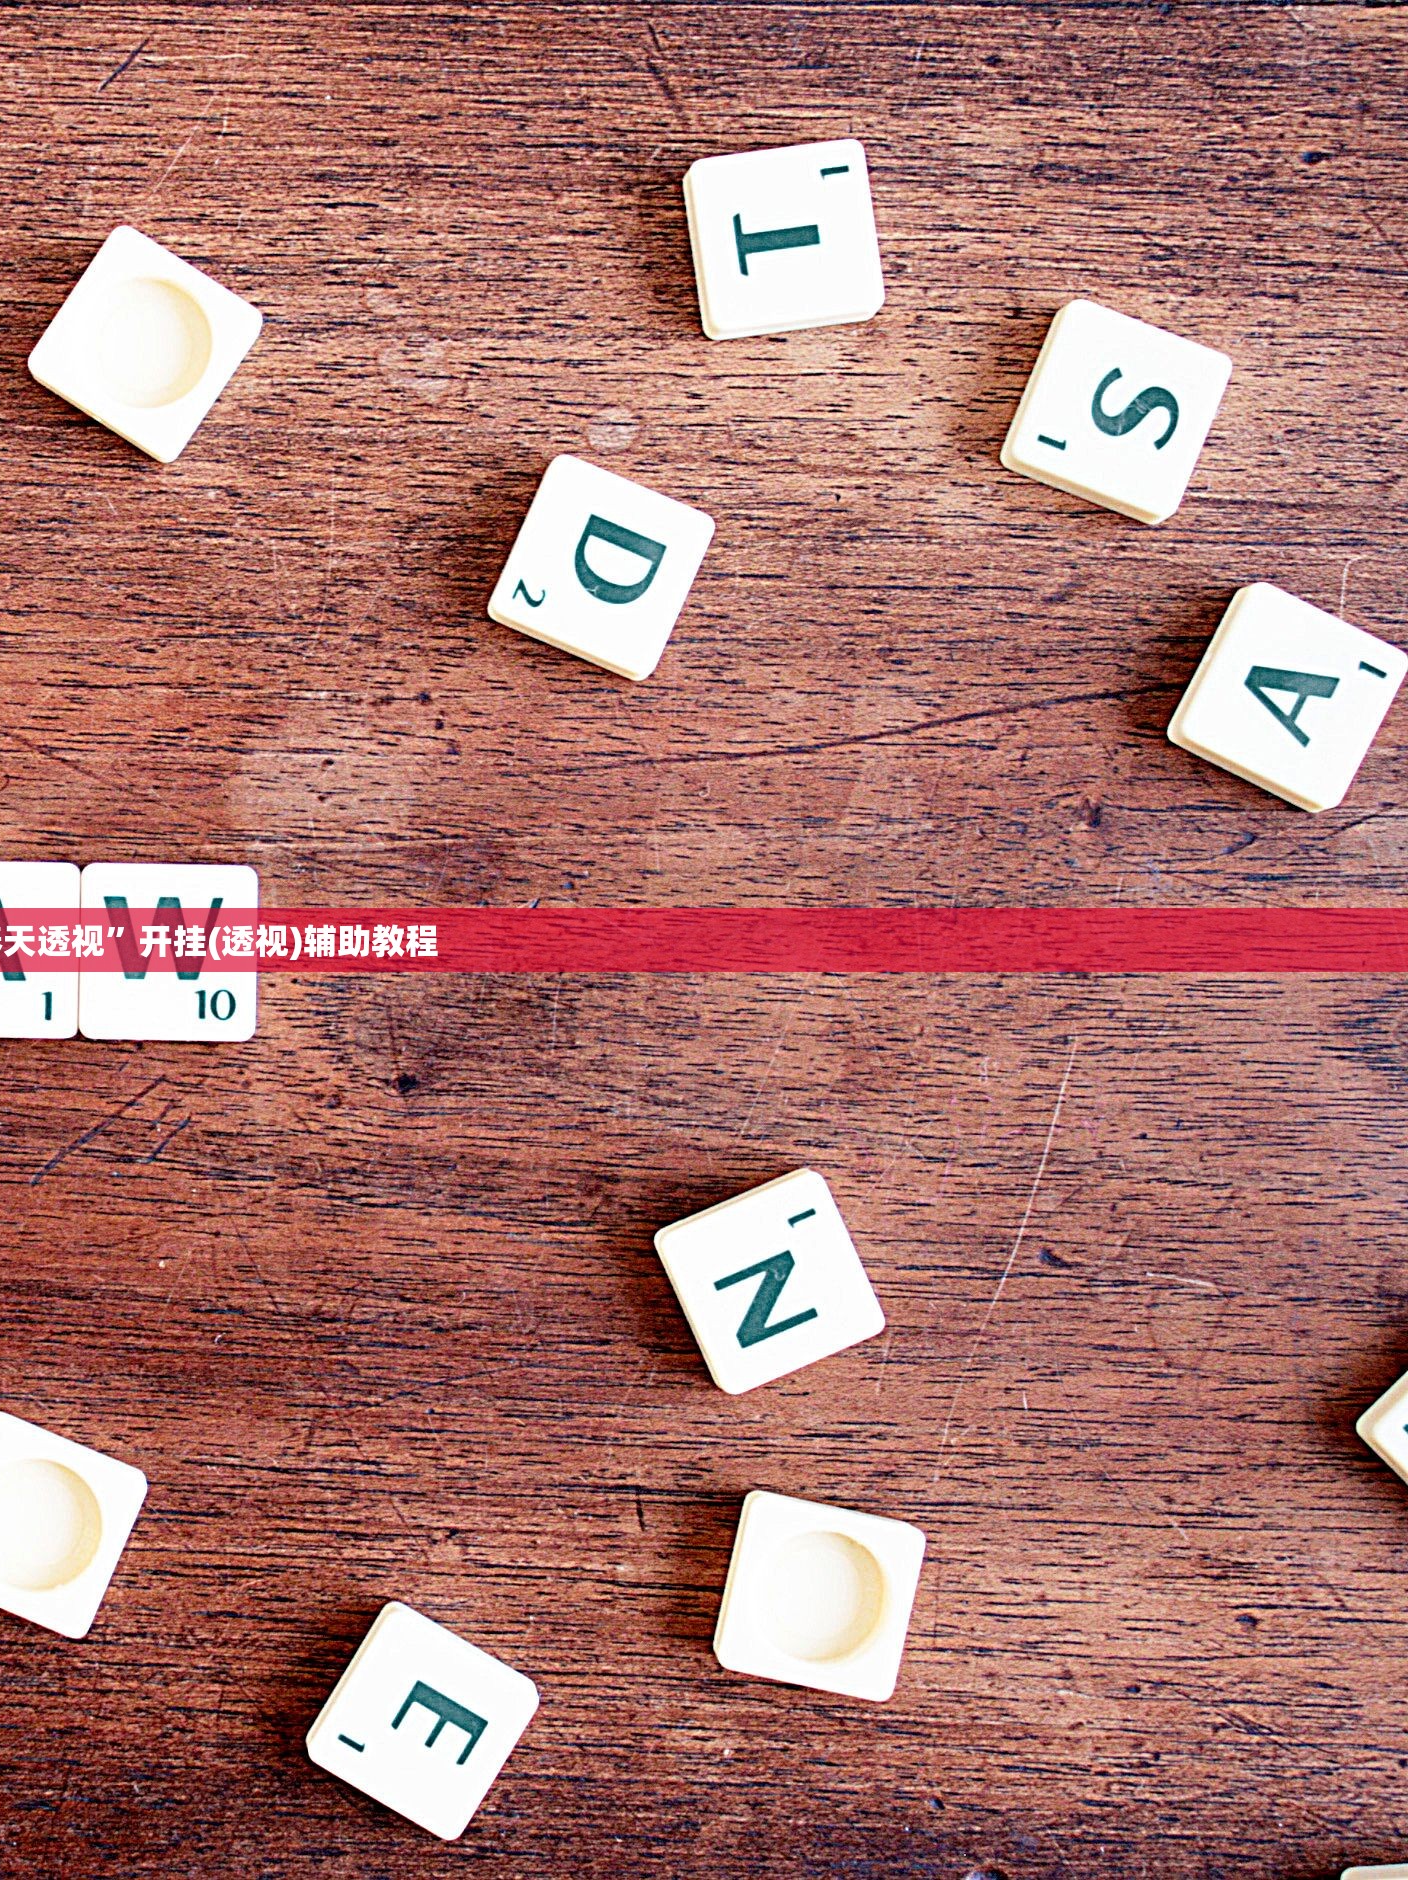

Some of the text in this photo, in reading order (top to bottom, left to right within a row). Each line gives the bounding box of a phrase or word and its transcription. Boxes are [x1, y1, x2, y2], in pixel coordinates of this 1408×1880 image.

[820, 165, 849, 178] 1
[733, 213, 820, 276] T
[1091, 368, 1179, 450] S
[1037, 434, 1066, 450] 1
[575, 514, 667, 604] D
[512, 579, 545, 607] 2
[1359, 661, 1387, 678] 1
[1244, 666, 1340, 747] A
[43, 992, 52, 1021] 1
[195, 990, 236, 1021] 10
[788, 1208, 816, 1228] 1
[714, 1250, 818, 1348] N
[391, 1680, 488, 1765] E
[338, 1734, 365, 1752] 1
